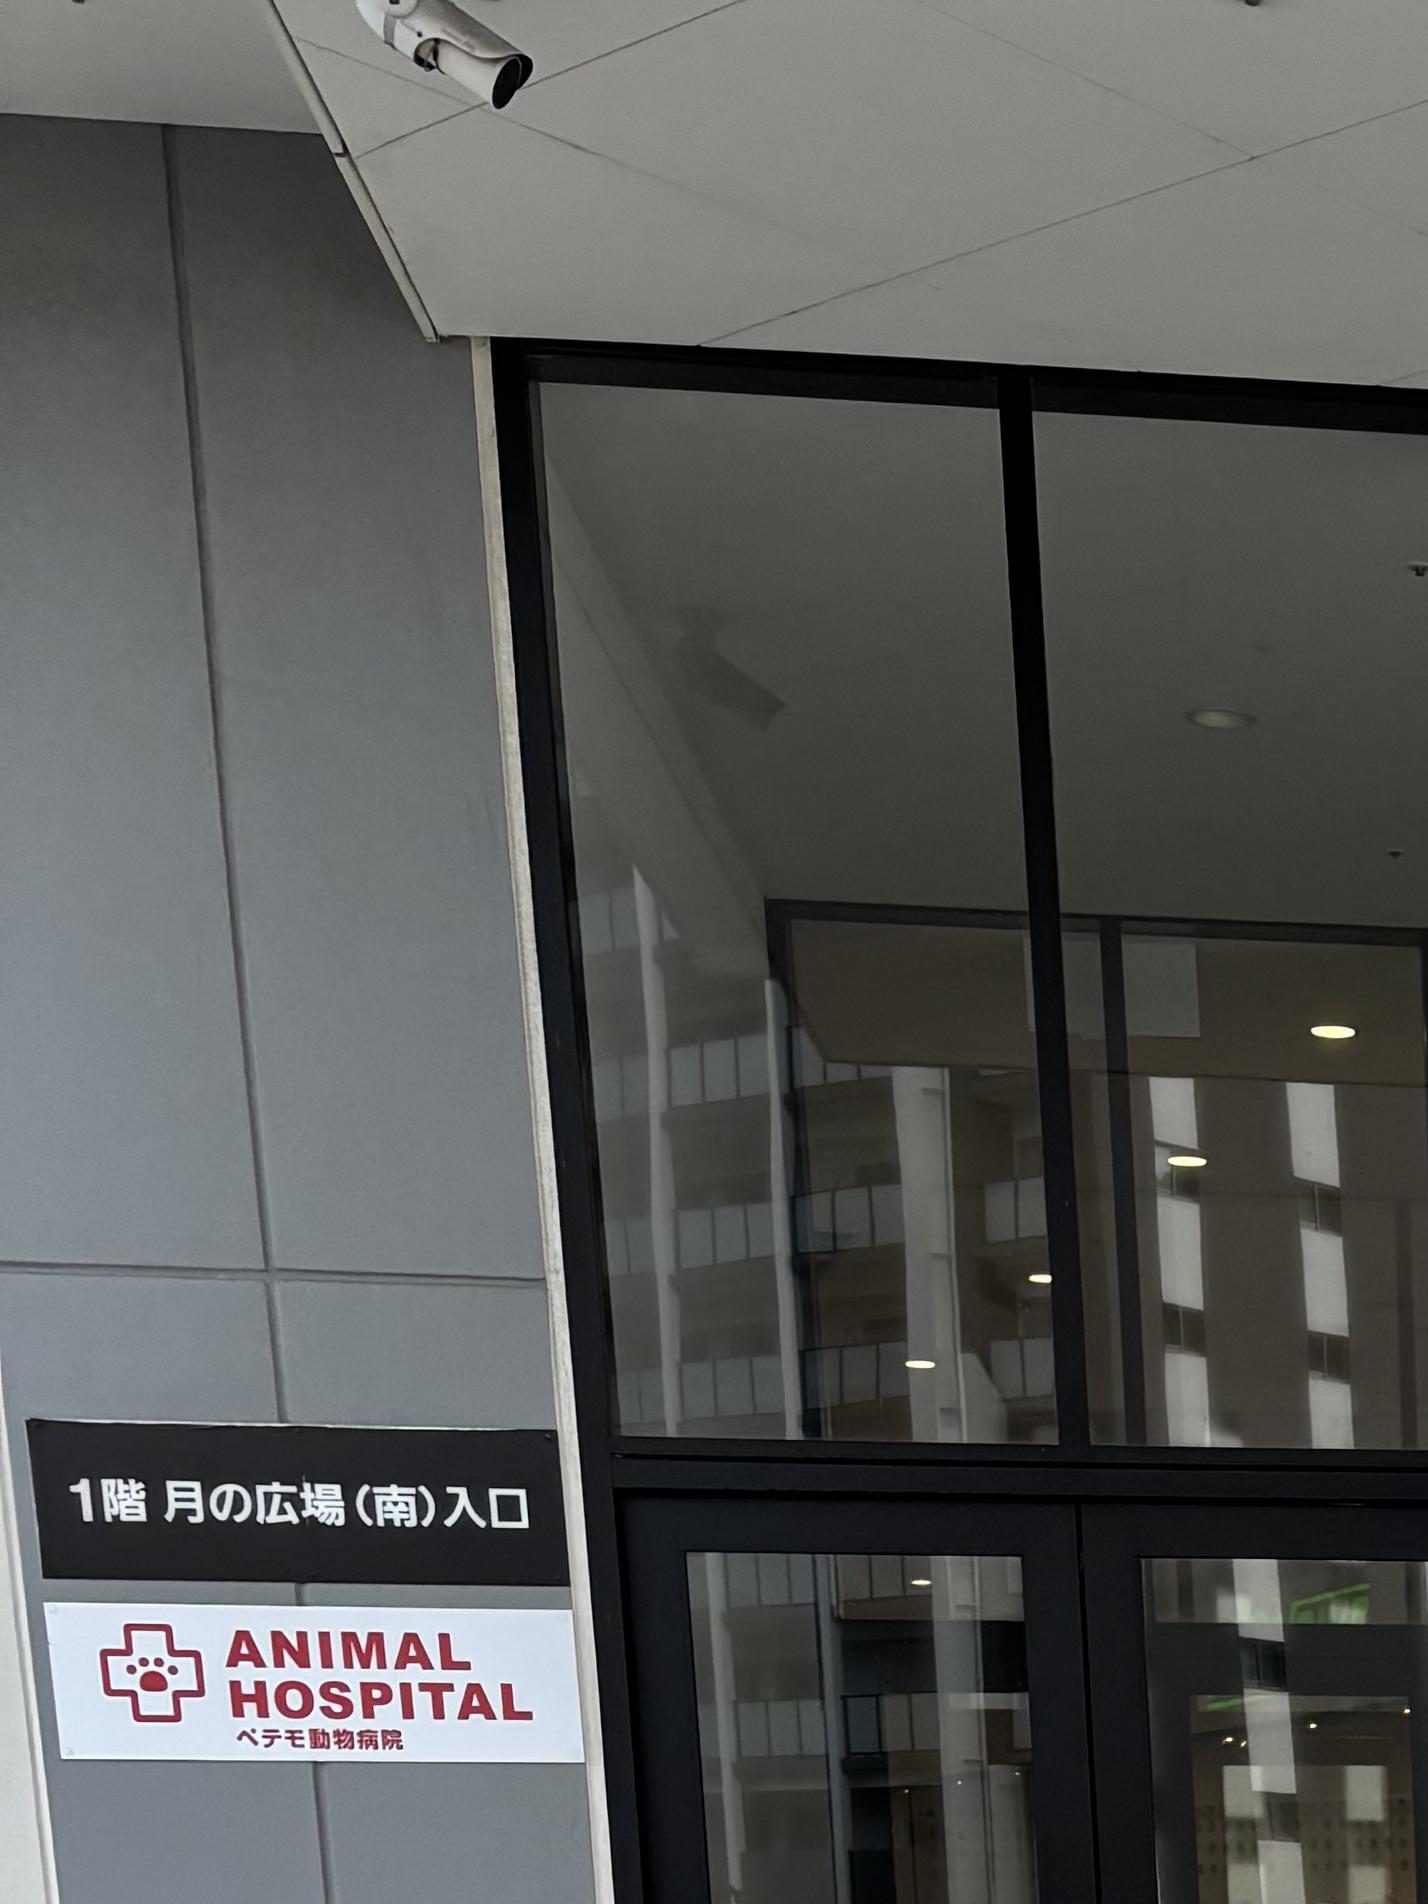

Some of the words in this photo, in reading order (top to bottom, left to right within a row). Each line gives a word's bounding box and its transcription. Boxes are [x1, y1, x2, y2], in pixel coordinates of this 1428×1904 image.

[68, 1477, 147, 1523] 1階
[225, 1629, 472, 1672] ANIMAL
[227, 1679, 534, 1722] HOSPITAL
[236, 1728, 404, 1751] ペテモ動物病院
